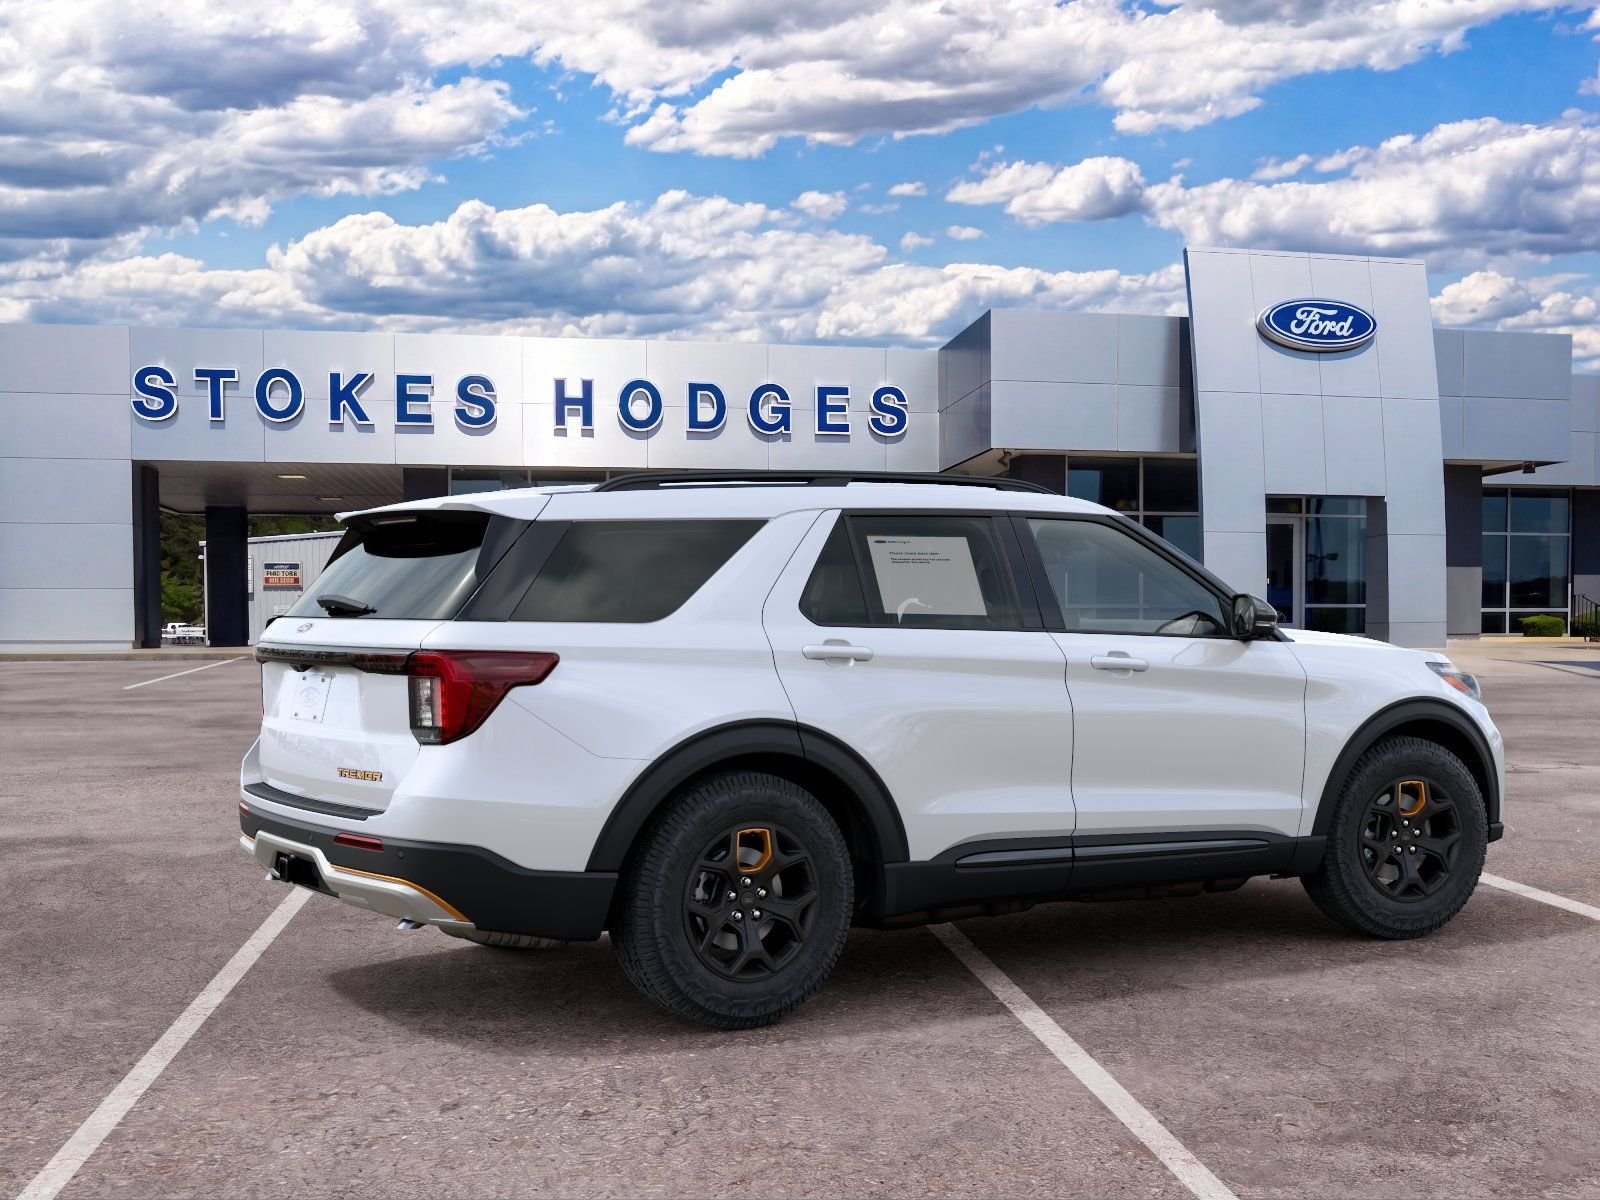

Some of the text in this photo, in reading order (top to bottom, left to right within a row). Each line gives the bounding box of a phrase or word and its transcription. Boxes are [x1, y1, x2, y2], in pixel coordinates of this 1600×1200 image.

[1290, 306, 1354, 337] Ford
[131, 365, 910, 437] STOKES HODGES
[337, 767, 383, 782] TREMOR
